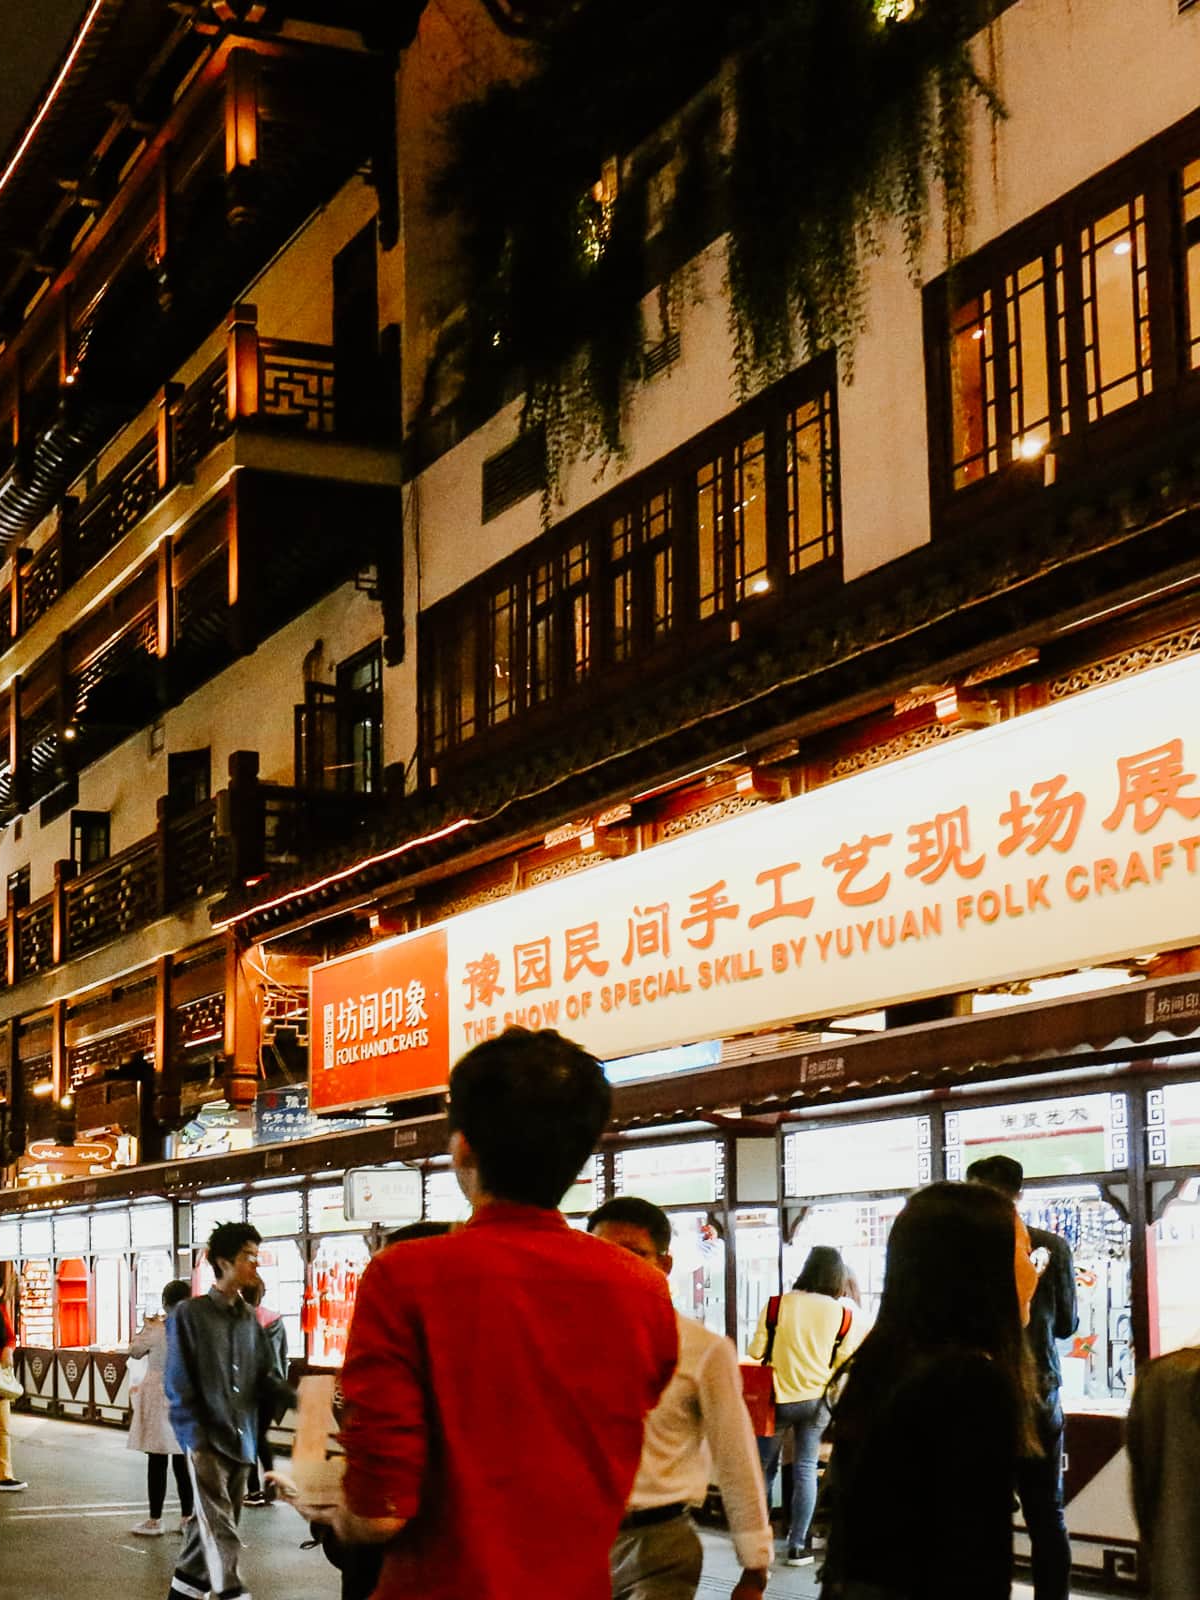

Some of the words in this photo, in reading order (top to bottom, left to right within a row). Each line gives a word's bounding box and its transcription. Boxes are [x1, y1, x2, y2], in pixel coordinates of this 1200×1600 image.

[462, 737, 1200, 1011] 豫园民间手工艺现场展
[336, 979, 428, 1043] 坊间印象
[463, 1014, 498, 1043] THE
[503, 999, 560, 1030] SHOW
[565, 991, 593, 1021] OF
[599, 966, 691, 1013] SPECIAL
[698, 948, 763, 990] SKILL
[771, 936, 807, 974] BY
[815, 903, 942, 962] YUYUAN
[956, 874, 1051, 929] FOLK
[336, 1044, 360, 1066] FOLK
[360, 1028, 429, 1060] HANDICRAFTS
